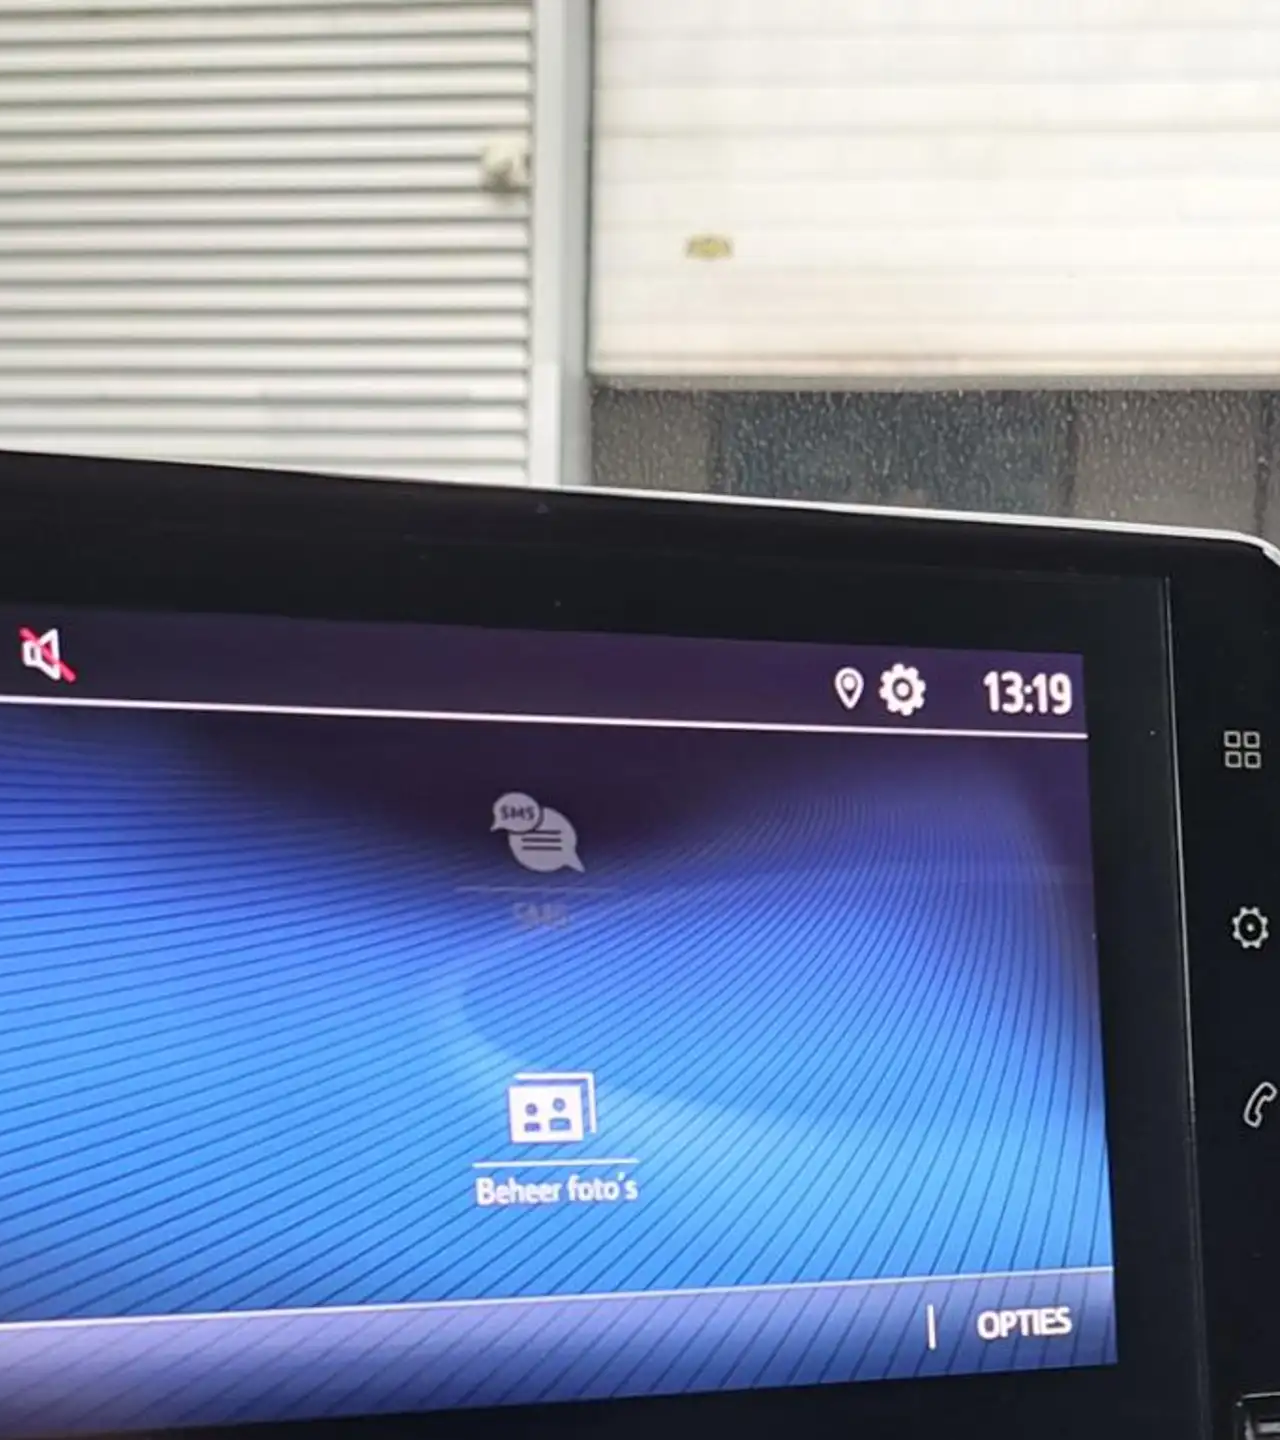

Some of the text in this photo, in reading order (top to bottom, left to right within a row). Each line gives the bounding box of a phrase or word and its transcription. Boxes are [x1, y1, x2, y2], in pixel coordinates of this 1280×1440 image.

[983, 670, 1073, 715] 13:19
[499, 804, 536, 821] SMS
[475, 1171, 639, 1207] Beheer foto's
[976, 1306, 1073, 1341] OPTIES
